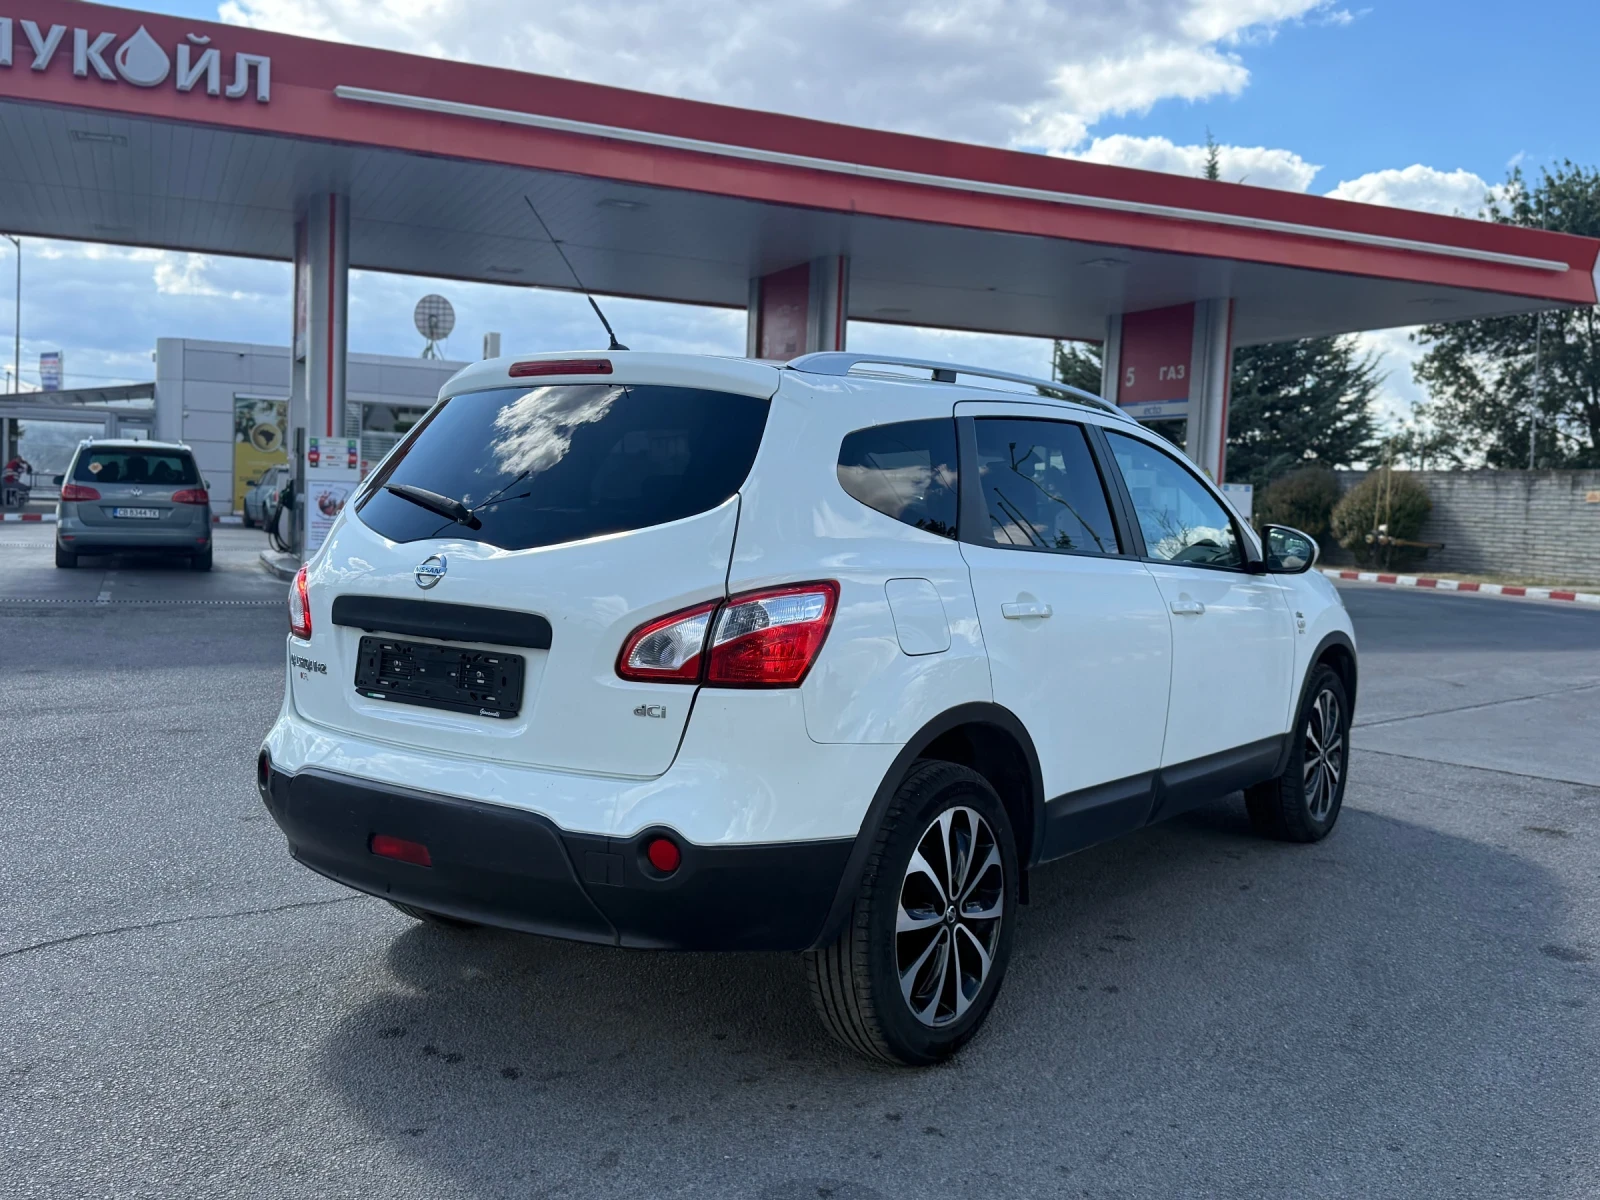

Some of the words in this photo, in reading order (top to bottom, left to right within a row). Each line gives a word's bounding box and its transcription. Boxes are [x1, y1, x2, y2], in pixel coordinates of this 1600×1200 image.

[1125, 367, 1135, 387] 5
[1159, 365, 1185, 381] ГАЗ
[633, 704, 666, 718] dCi
